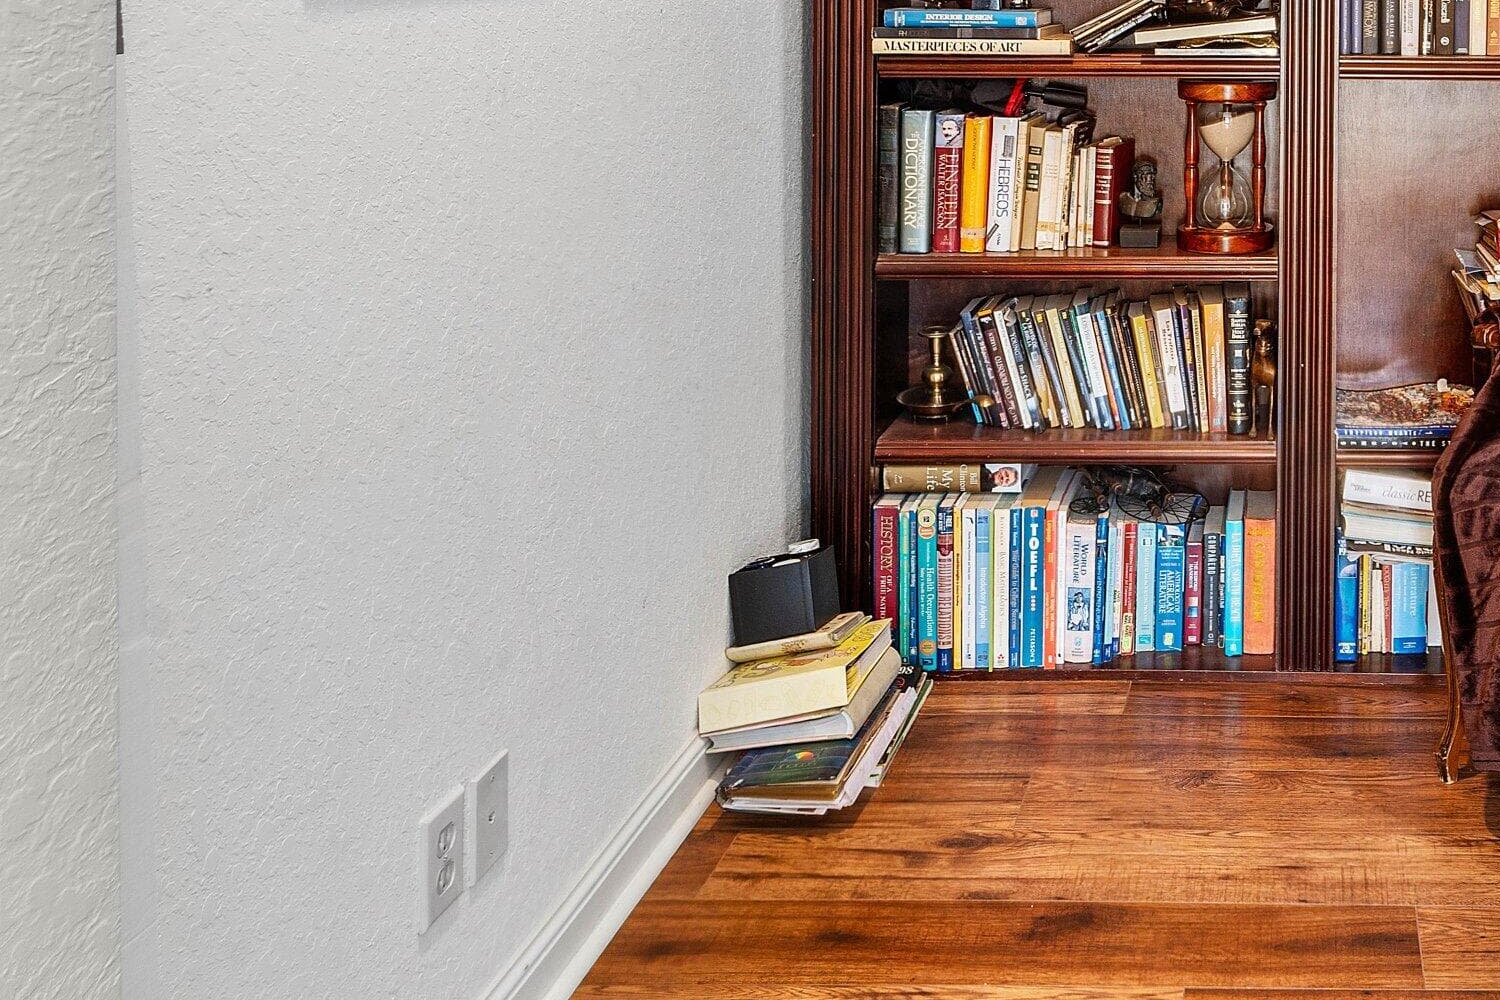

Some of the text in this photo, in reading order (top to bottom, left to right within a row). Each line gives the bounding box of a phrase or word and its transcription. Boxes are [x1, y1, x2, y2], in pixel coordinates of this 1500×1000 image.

[925, 13, 964, 21] INTERIOR
[884, 41, 1022, 52] MASTERPIECES OF ART
[905, 138, 918, 229] DICTIONARY
[917, 138, 926, 229] AMERICAN HERITAGE
[944, 153, 958, 229] EINSTEIN
[996, 159, 1011, 218] HEBREOS
[937, 189, 945, 229] ISAACSON
[1009, 332, 1020, 356] YOUNG
[1021, 372, 1033, 400] SHACK
[926, 467, 938, 491] Life
[940, 469, 953, 489] My
[960, 464, 968, 491] Clinton
[1381, 486, 1416, 501] classic
[880, 515, 893, 571] HISTORY
[887, 575, 893, 586] OF
[1073, 535, 1081, 583] LITERATURE
[1081, 543, 1089, 575] WORLD
[1207, 535, 1217, 575] COMPAÑERO
[1012, 563, 1020, 580] Guide
[1159, 570, 1167, 613] LITERATURE
[1231, 533, 1241, 621] LA DIETA SOUTH BEACH
[926, 568, 934, 637] Health Occupations
[938, 562, 952, 641] HUMAN RELATIONS
[979, 567, 988, 628] Introductory Algebra
[1010, 587, 1019, 608] College
[1011, 609, 1019, 630] Success
